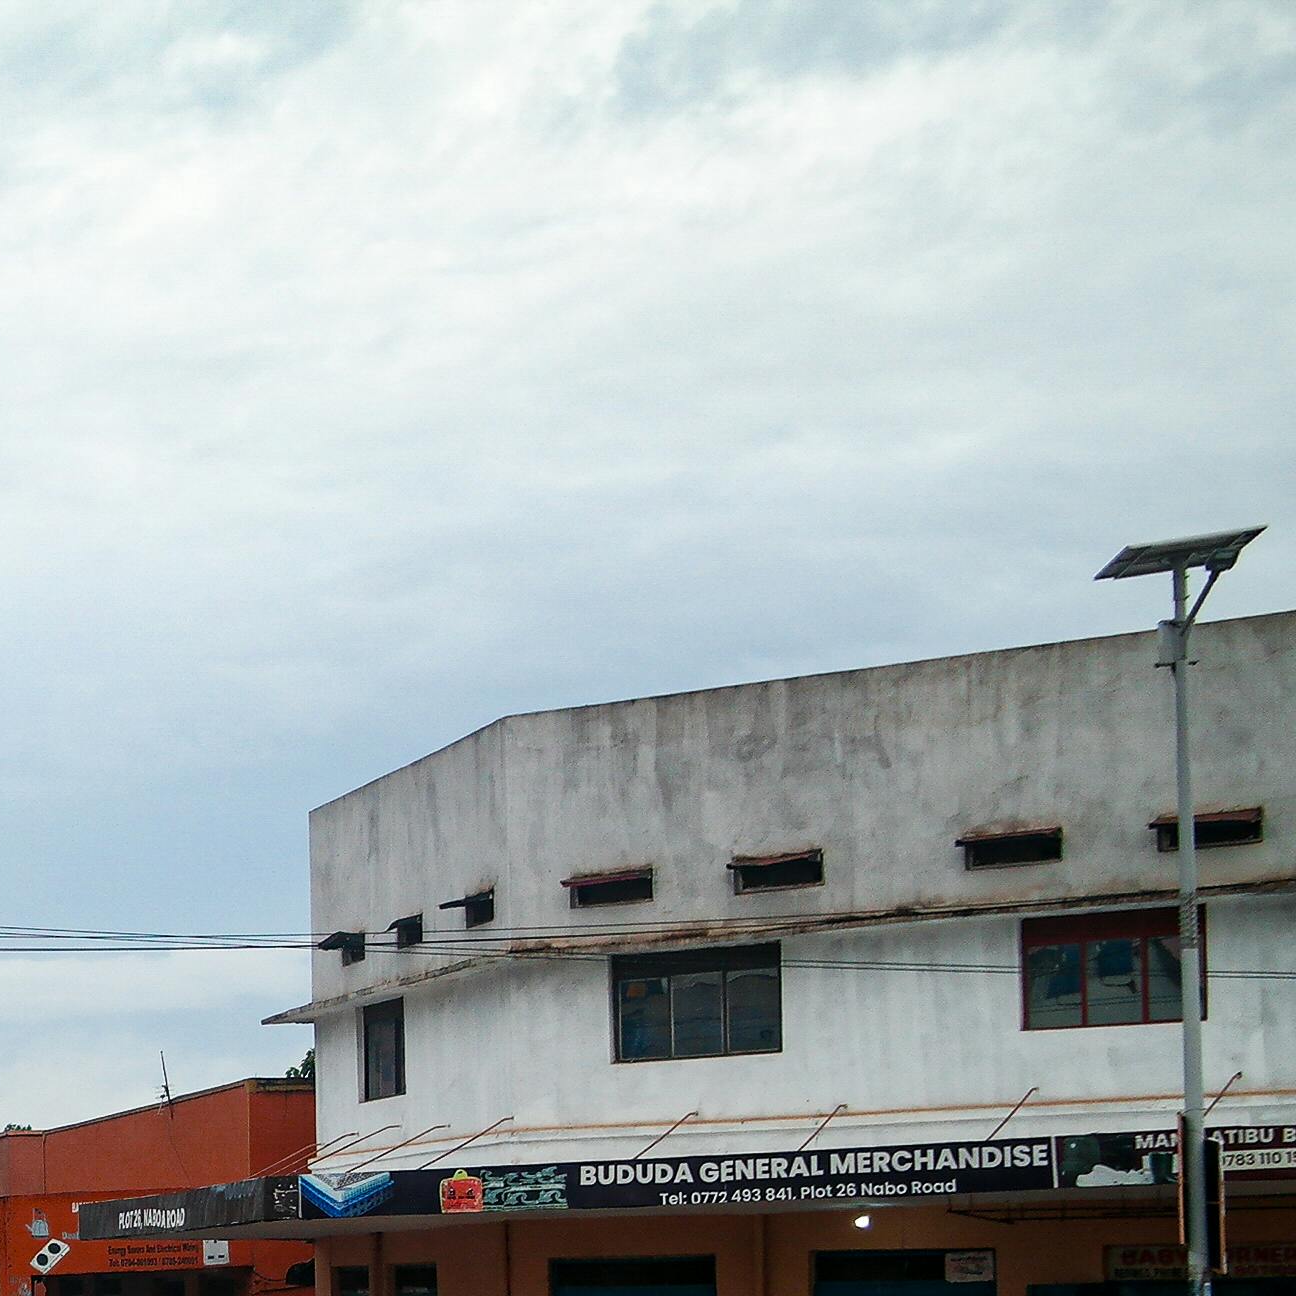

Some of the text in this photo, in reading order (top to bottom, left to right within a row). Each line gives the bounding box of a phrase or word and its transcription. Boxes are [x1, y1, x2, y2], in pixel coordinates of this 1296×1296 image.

[579, 1143, 1049, 1186] BUDUDA GENERAL MERCHANDISE
[1260, 1152, 1282, 1164] 110
[660, 1191, 687, 1205] Tel:
[691, 1190, 728, 1205] 0772
[731, 1188, 762, 1202] 493
[800, 1183, 833, 1199] Plot
[836, 1183, 857, 1197] 26
[861, 1181, 908, 1196] Nabo
[911, 1178, 957, 1194] Road
[118, 1210, 134, 1230] PLOT
[143, 1208, 166, 1229] NABOA
[166, 1207, 186, 1229] ROAD
